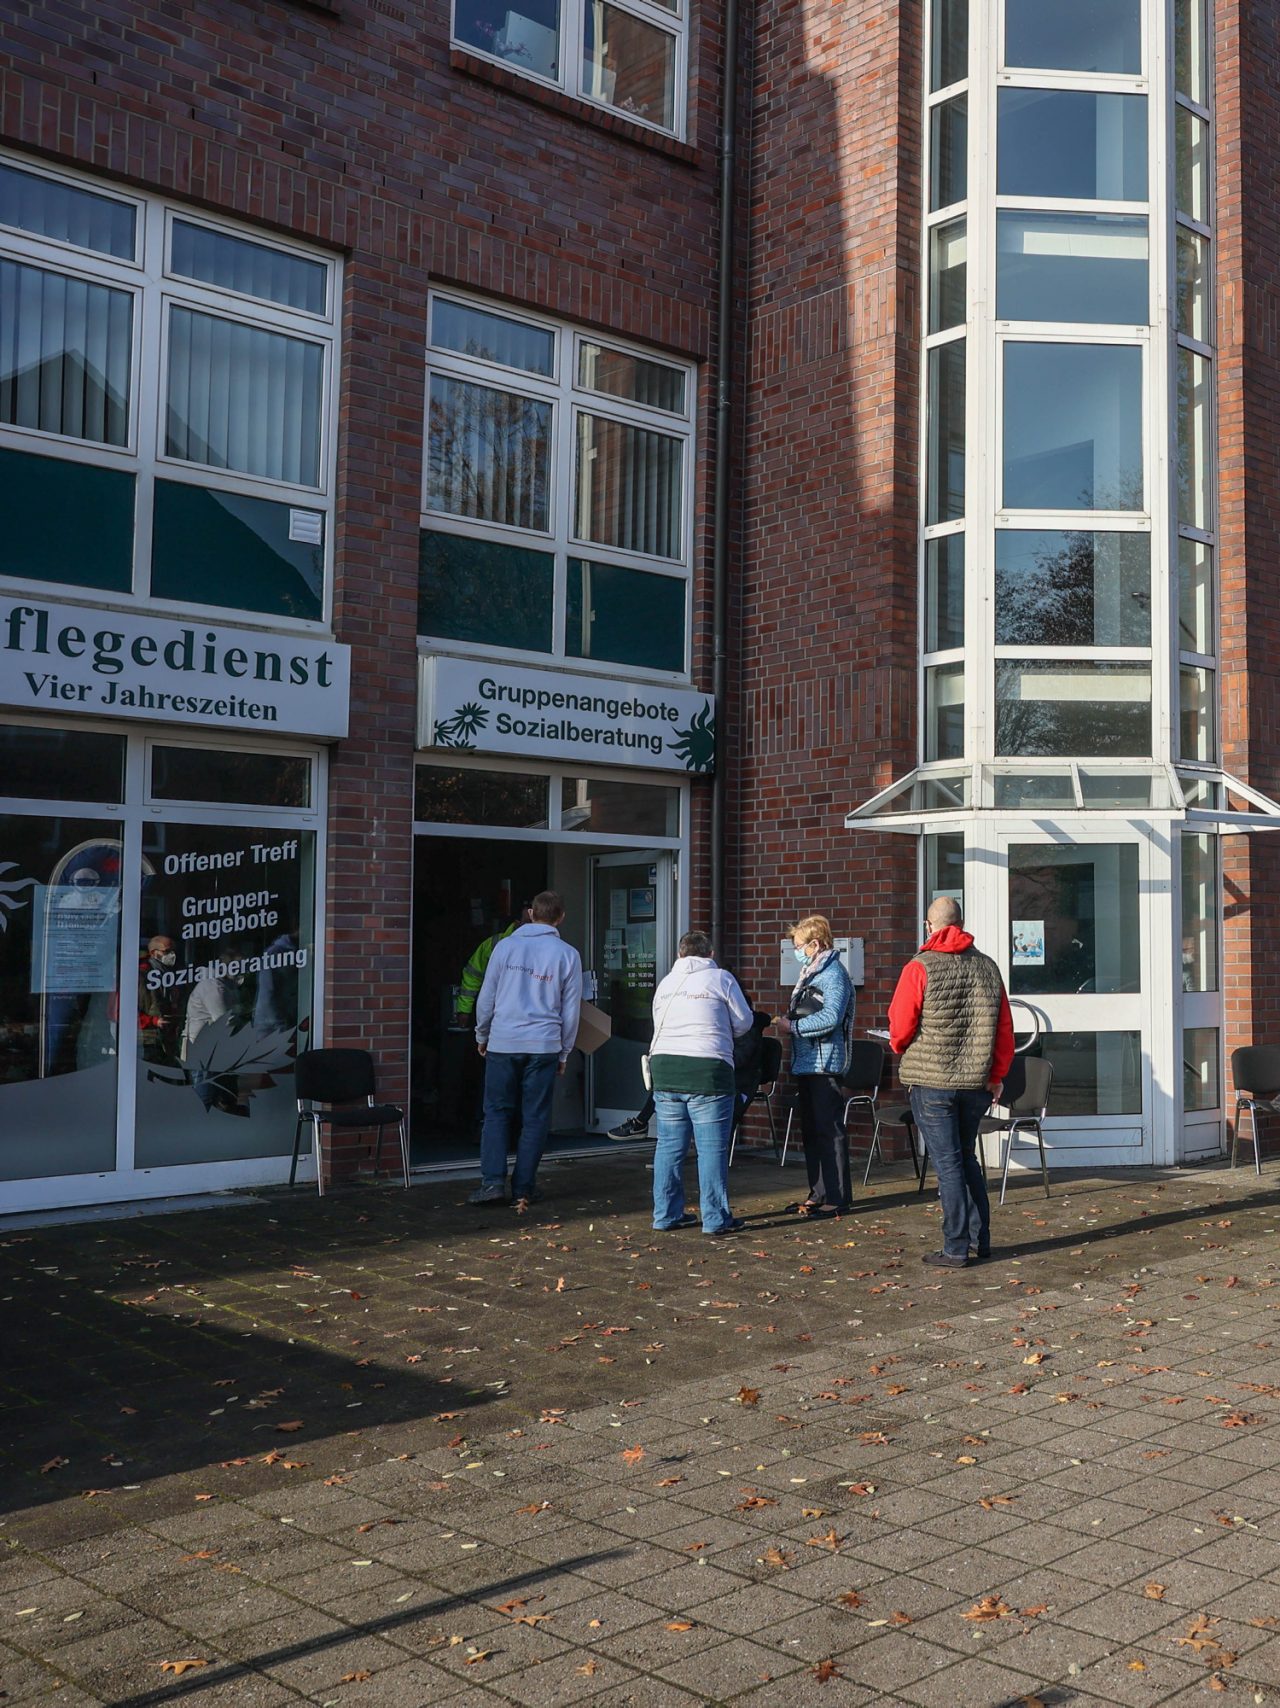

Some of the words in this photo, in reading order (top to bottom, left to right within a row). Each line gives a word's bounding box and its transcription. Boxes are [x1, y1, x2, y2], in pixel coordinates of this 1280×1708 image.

[3, 606, 334, 688] flegedienst
[24, 671, 93, 702] Vier
[101, 681, 278, 721] Jahreszeiten
[478, 678, 680, 722] Gruppenangebote
[496, 713, 663, 755] Sozialberatung
[164, 848, 244, 876] Offener
[250, 840, 298, 864] Treff
[181, 908, 278, 940] angebote
[182, 889, 279, 919] Gruppen-
[146, 948, 308, 991] Sozialberatung
